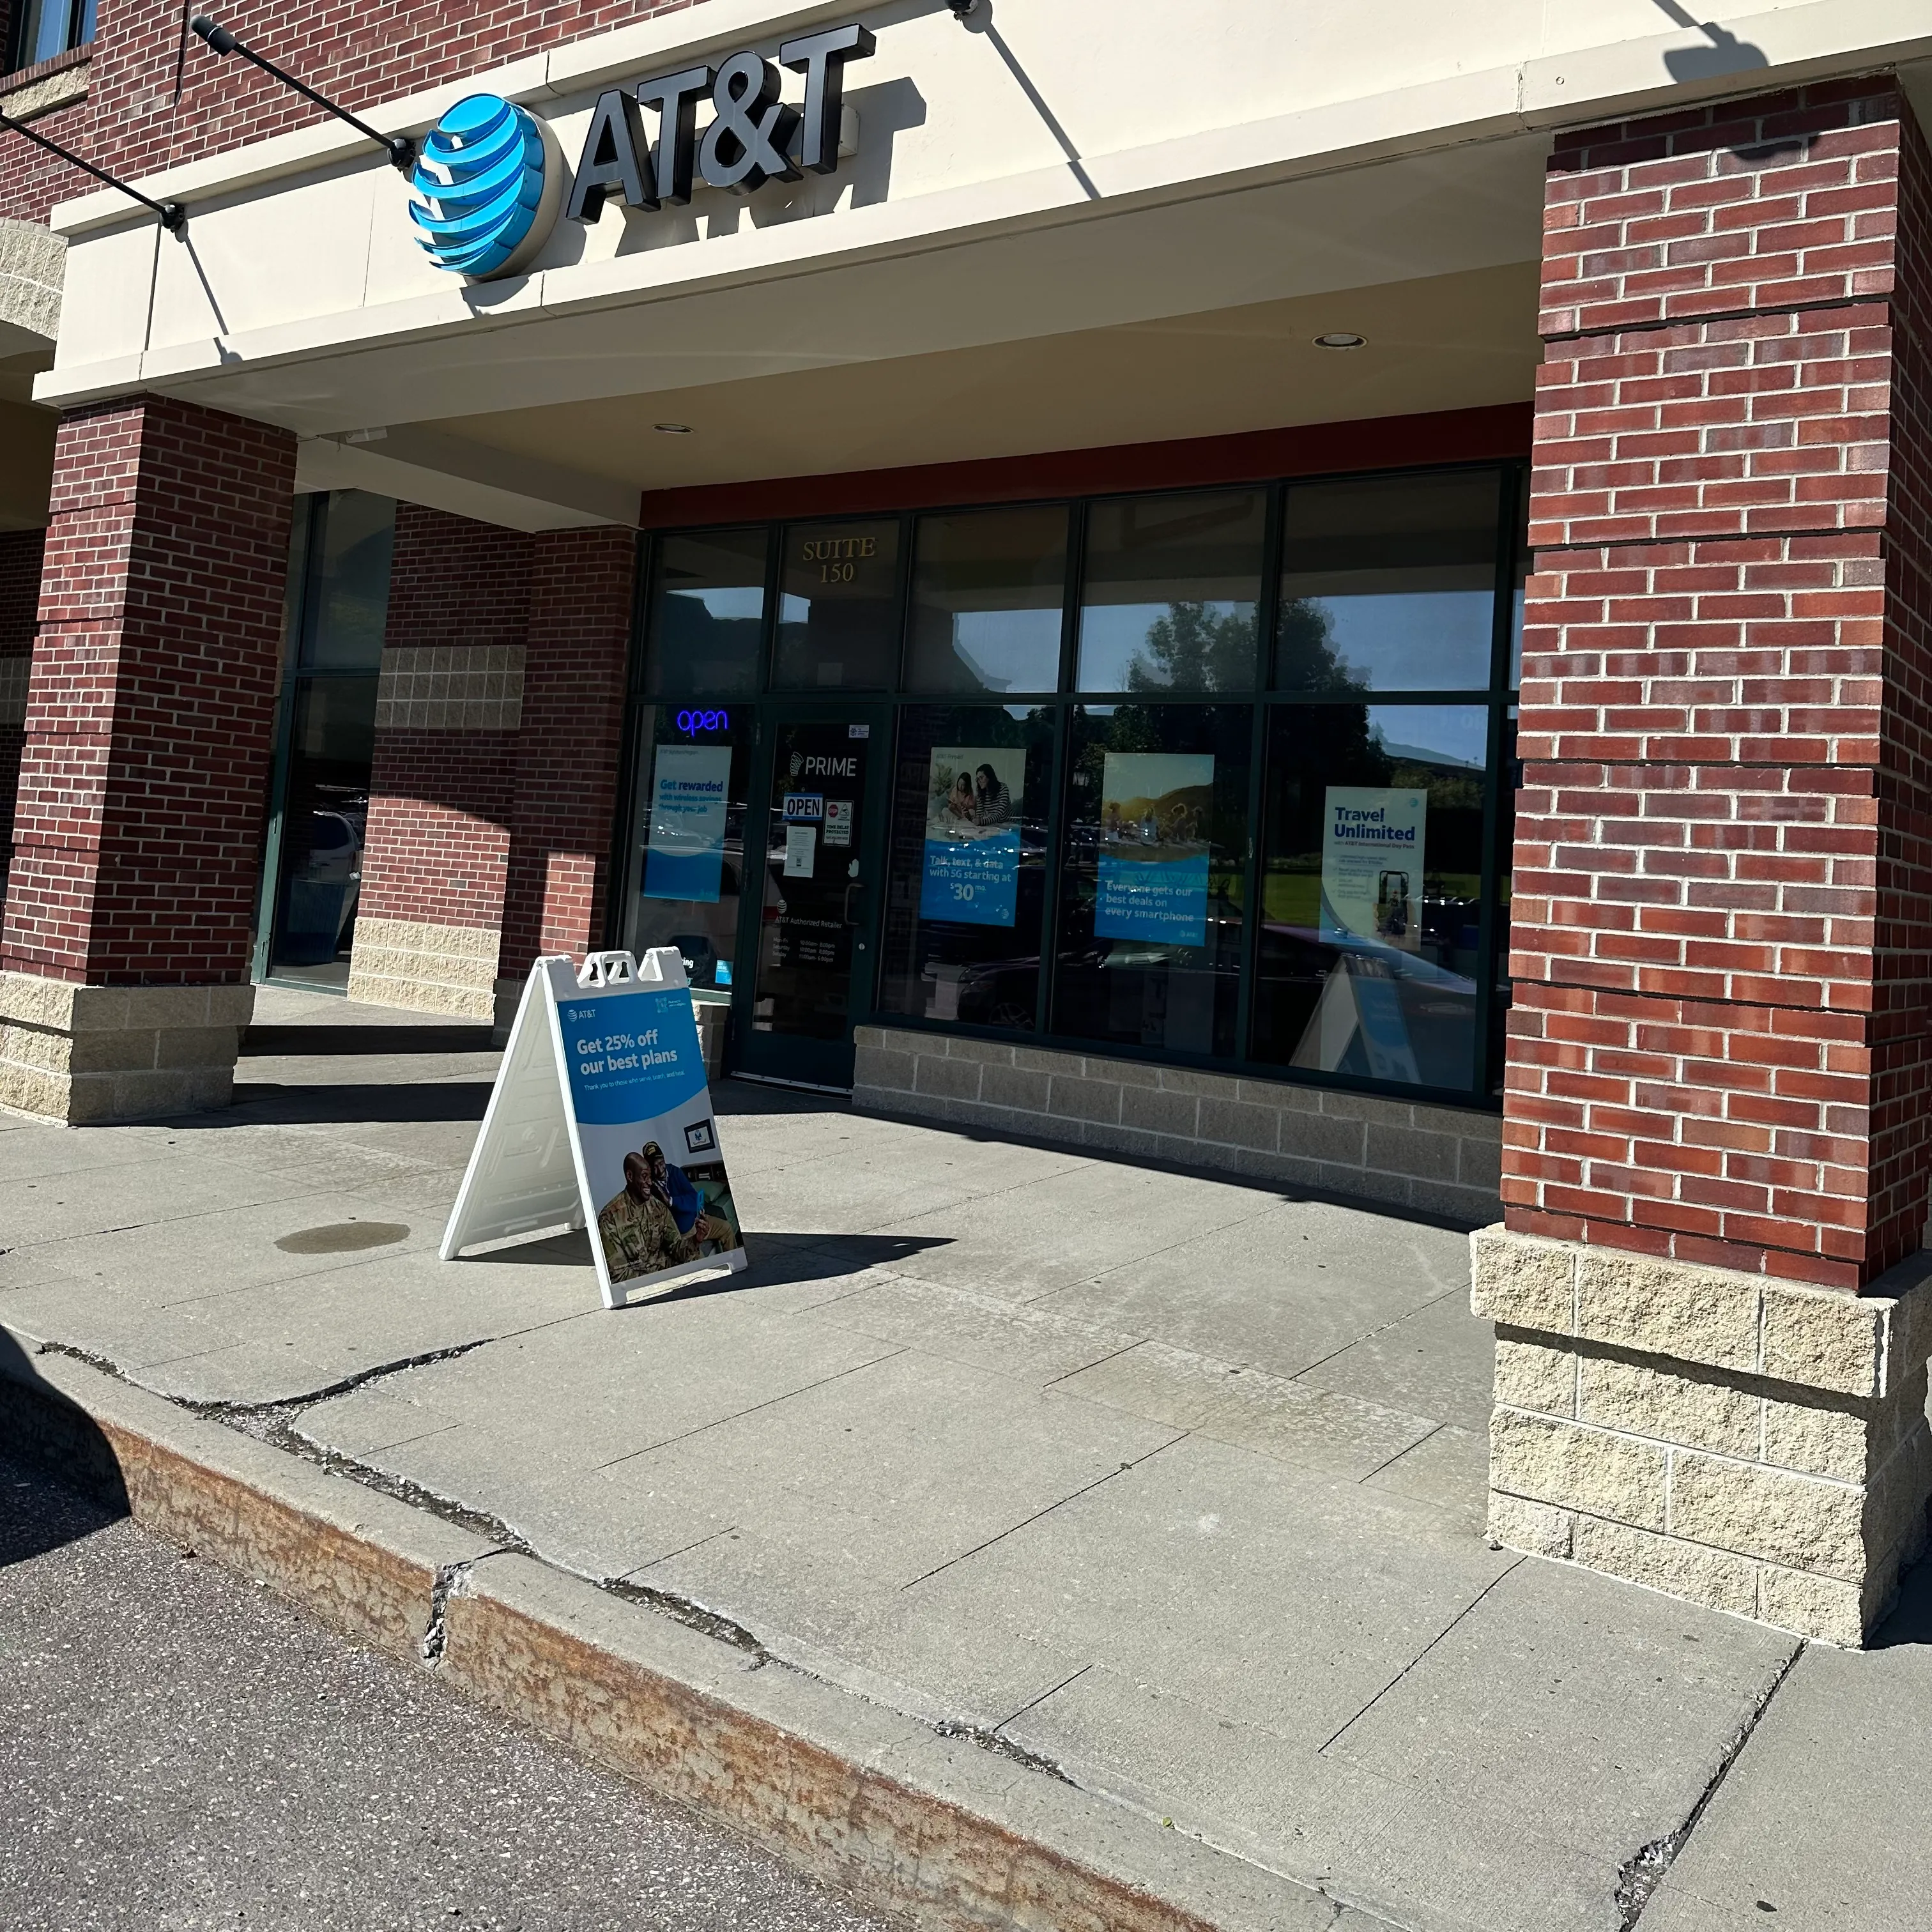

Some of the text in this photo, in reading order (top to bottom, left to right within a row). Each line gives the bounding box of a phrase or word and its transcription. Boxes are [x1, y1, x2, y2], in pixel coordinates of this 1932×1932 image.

[567, 22, 876, 225] AT&T
[802, 537, 875, 561] SUITE
[820, 562, 854, 583] 150
[677, 710, 729, 738] open
[805, 756, 857, 776] PRIME
[660, 779, 723, 792] Get rewarded
[698, 805, 708, 814] job
[787, 798, 820, 816] OPEN
[1335, 807, 1384, 822] Travel
[1334, 824, 1415, 841] Unlimited
[930, 855, 1004, 869] Talk, text, & data
[930, 867, 1011, 884] with 5G starting at
[1107, 881, 1193, 896] Everyone gets our
[1106, 893, 1167, 907] best deals on
[775, 916, 843, 929] AT&T Authorized Retailer
[1105, 907, 1194, 922] every smartphone
[578, 1009, 596, 1020] AT&T
[577, 1029, 658, 1055] Get 25% off
[580, 1049, 678, 1075] our best plans
